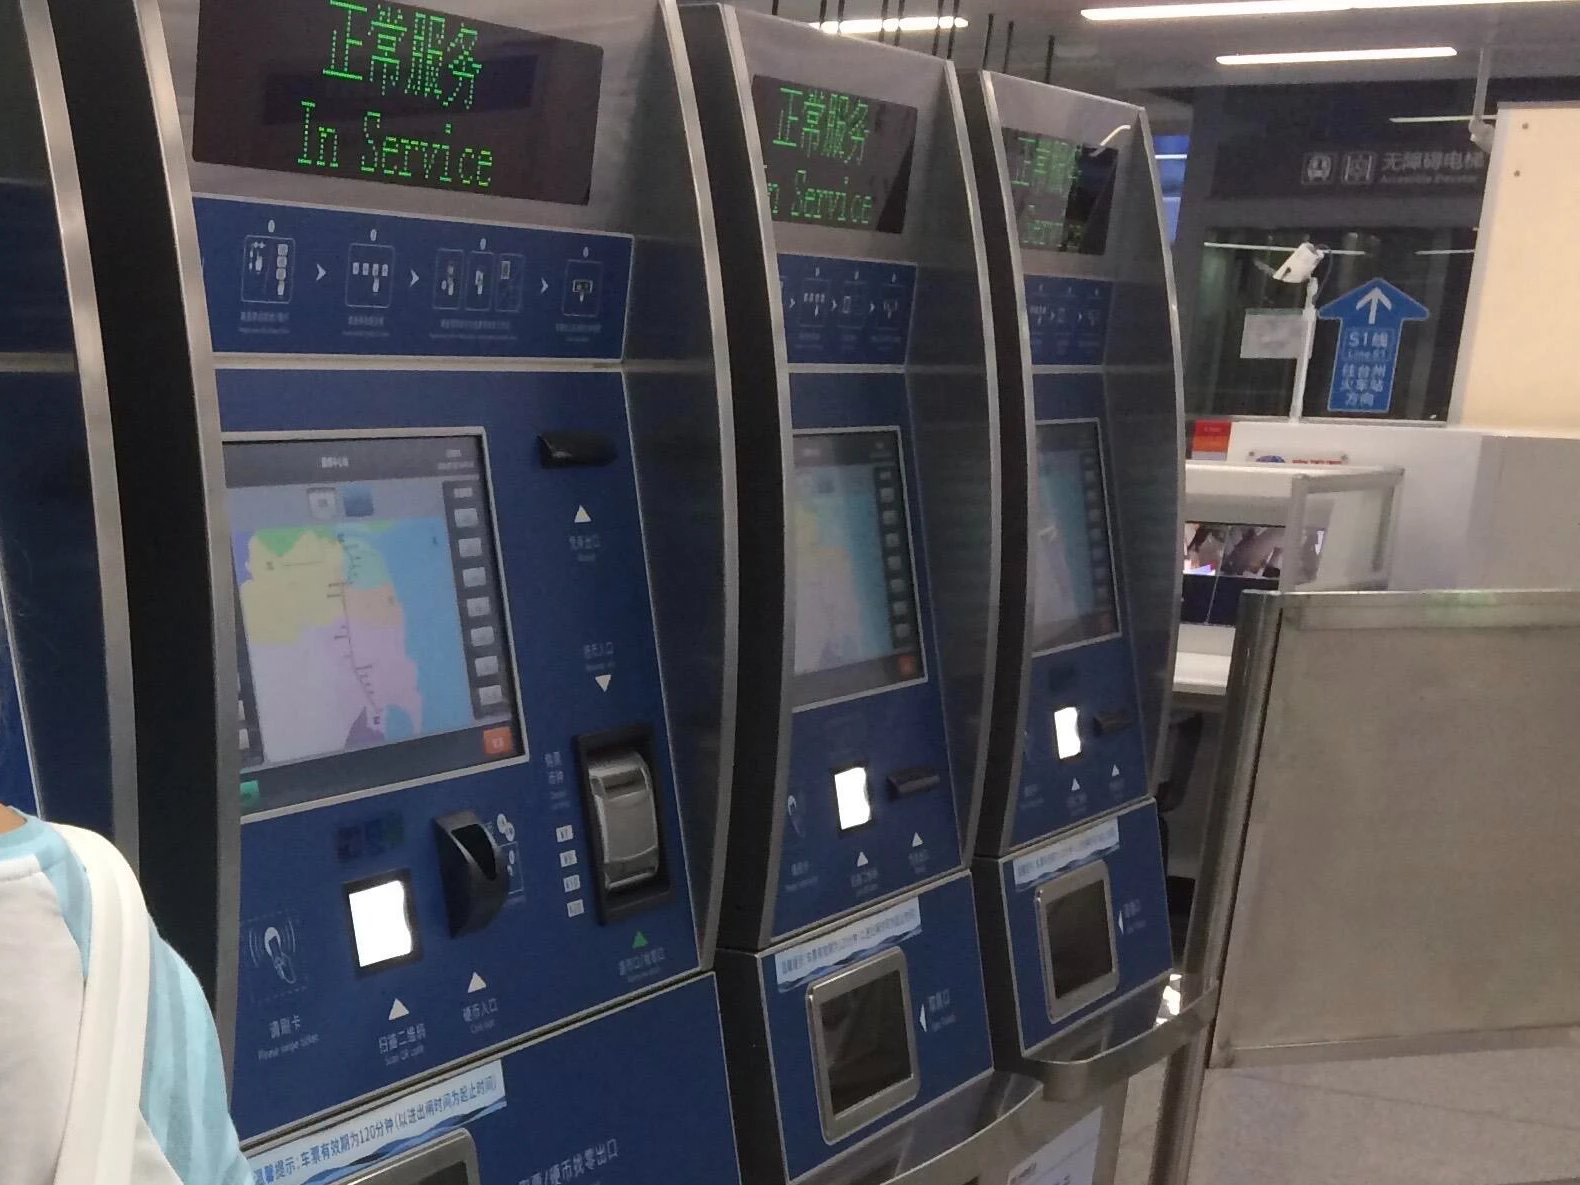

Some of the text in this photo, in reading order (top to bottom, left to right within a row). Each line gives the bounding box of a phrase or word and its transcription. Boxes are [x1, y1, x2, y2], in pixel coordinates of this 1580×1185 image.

[323, 0, 482, 110] 正常服务
[298, 100, 493, 187] In Service
[773, 87, 870, 166] 正常服务
[791, 169, 872, 224] Service
